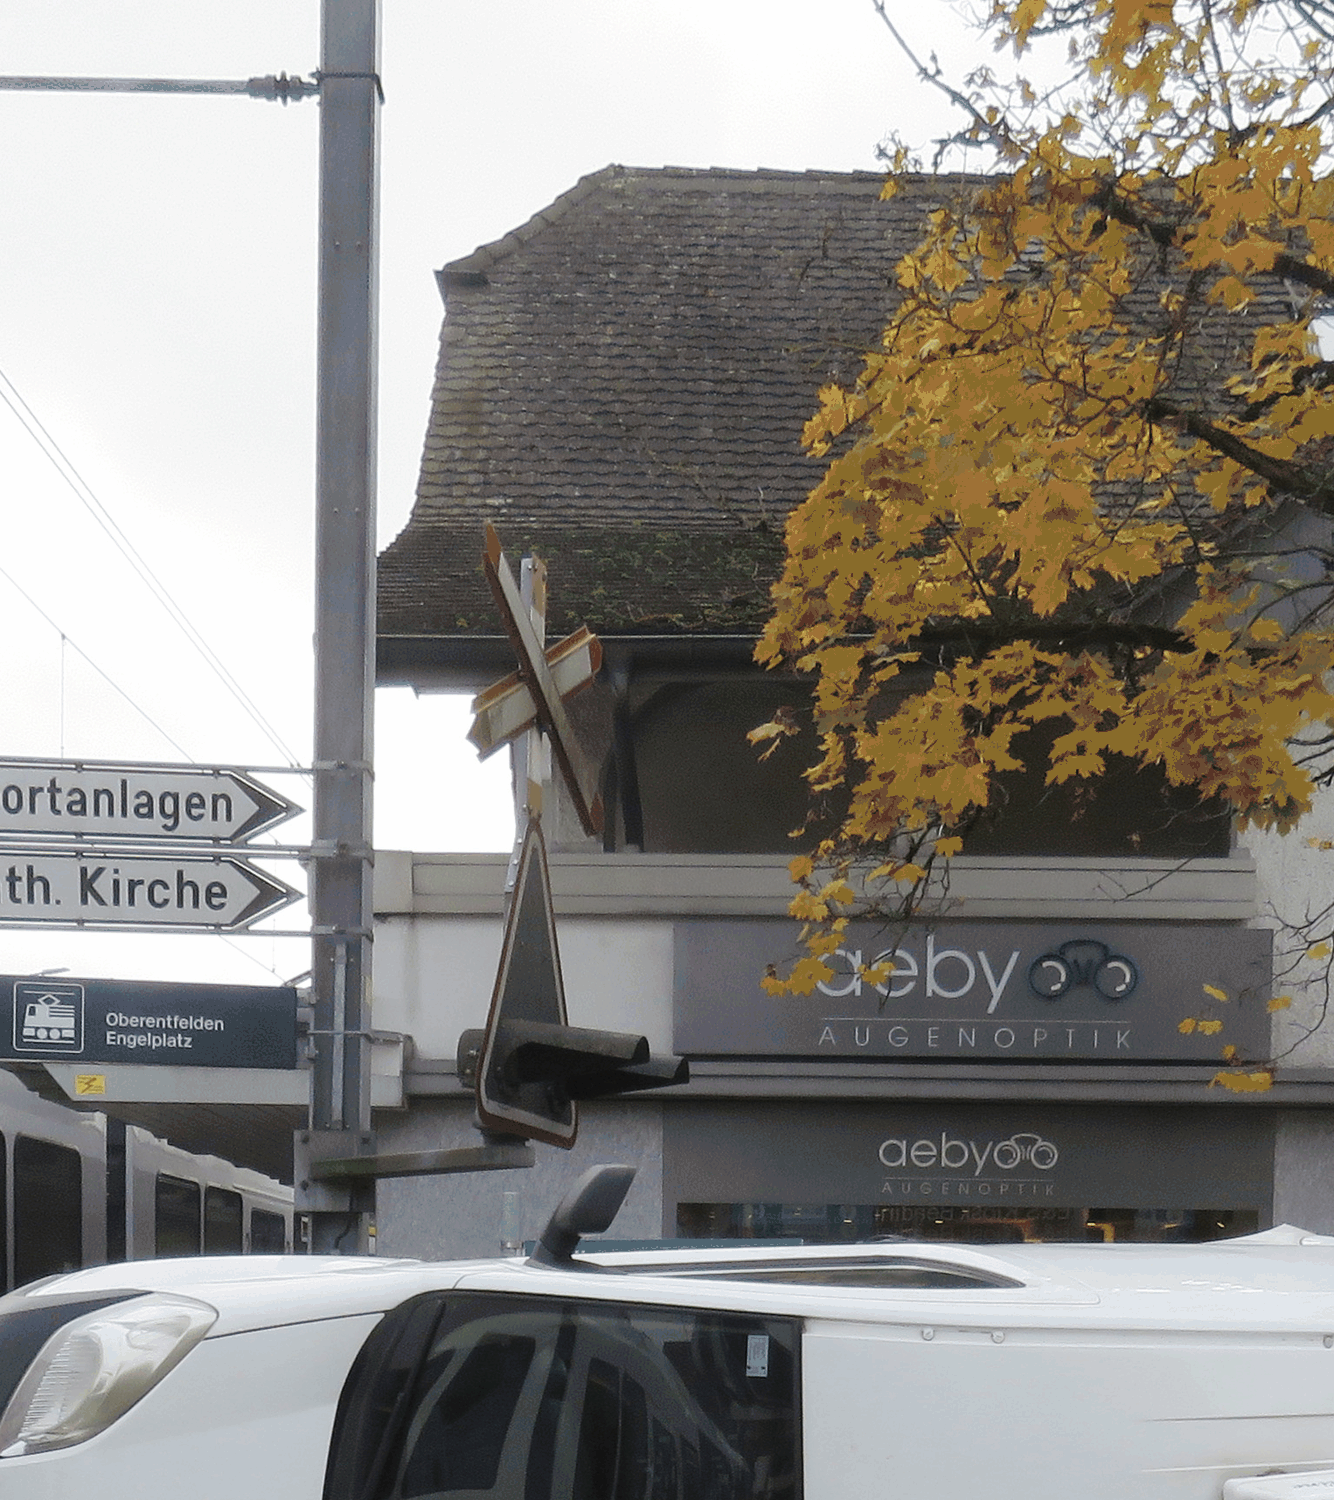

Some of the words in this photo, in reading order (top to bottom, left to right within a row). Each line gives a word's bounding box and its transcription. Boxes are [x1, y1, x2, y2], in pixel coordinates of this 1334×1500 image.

[79, 866, 228, 911] Kirche
[817, 934, 1019, 1014] aeby
[105, 1012, 225, 1032] Oberentfelden
[105, 1032, 193, 1049] Engelplatz
[818, 1025, 1130, 1049] AUGENOPTIK
[881, 1182, 1054, 1196] AUGENOPTIK
